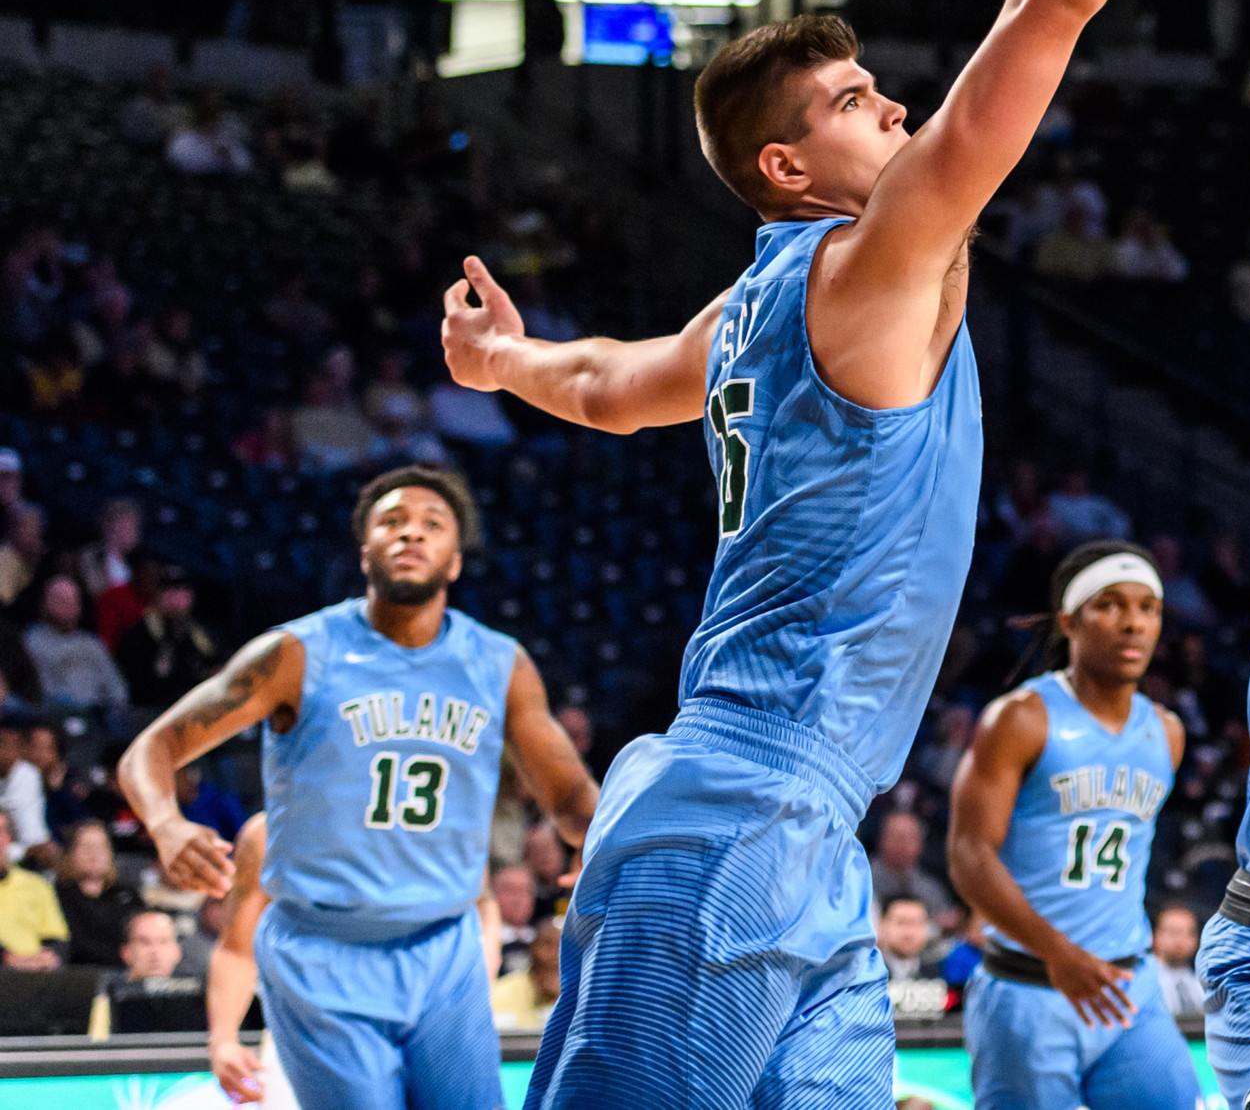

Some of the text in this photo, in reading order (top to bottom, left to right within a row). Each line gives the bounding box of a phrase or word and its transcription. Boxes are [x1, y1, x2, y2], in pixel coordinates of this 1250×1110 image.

[338, 692, 491, 756] TULANE
[364, 751, 450, 833] 13
[1060, 817, 1132, 892] 14
